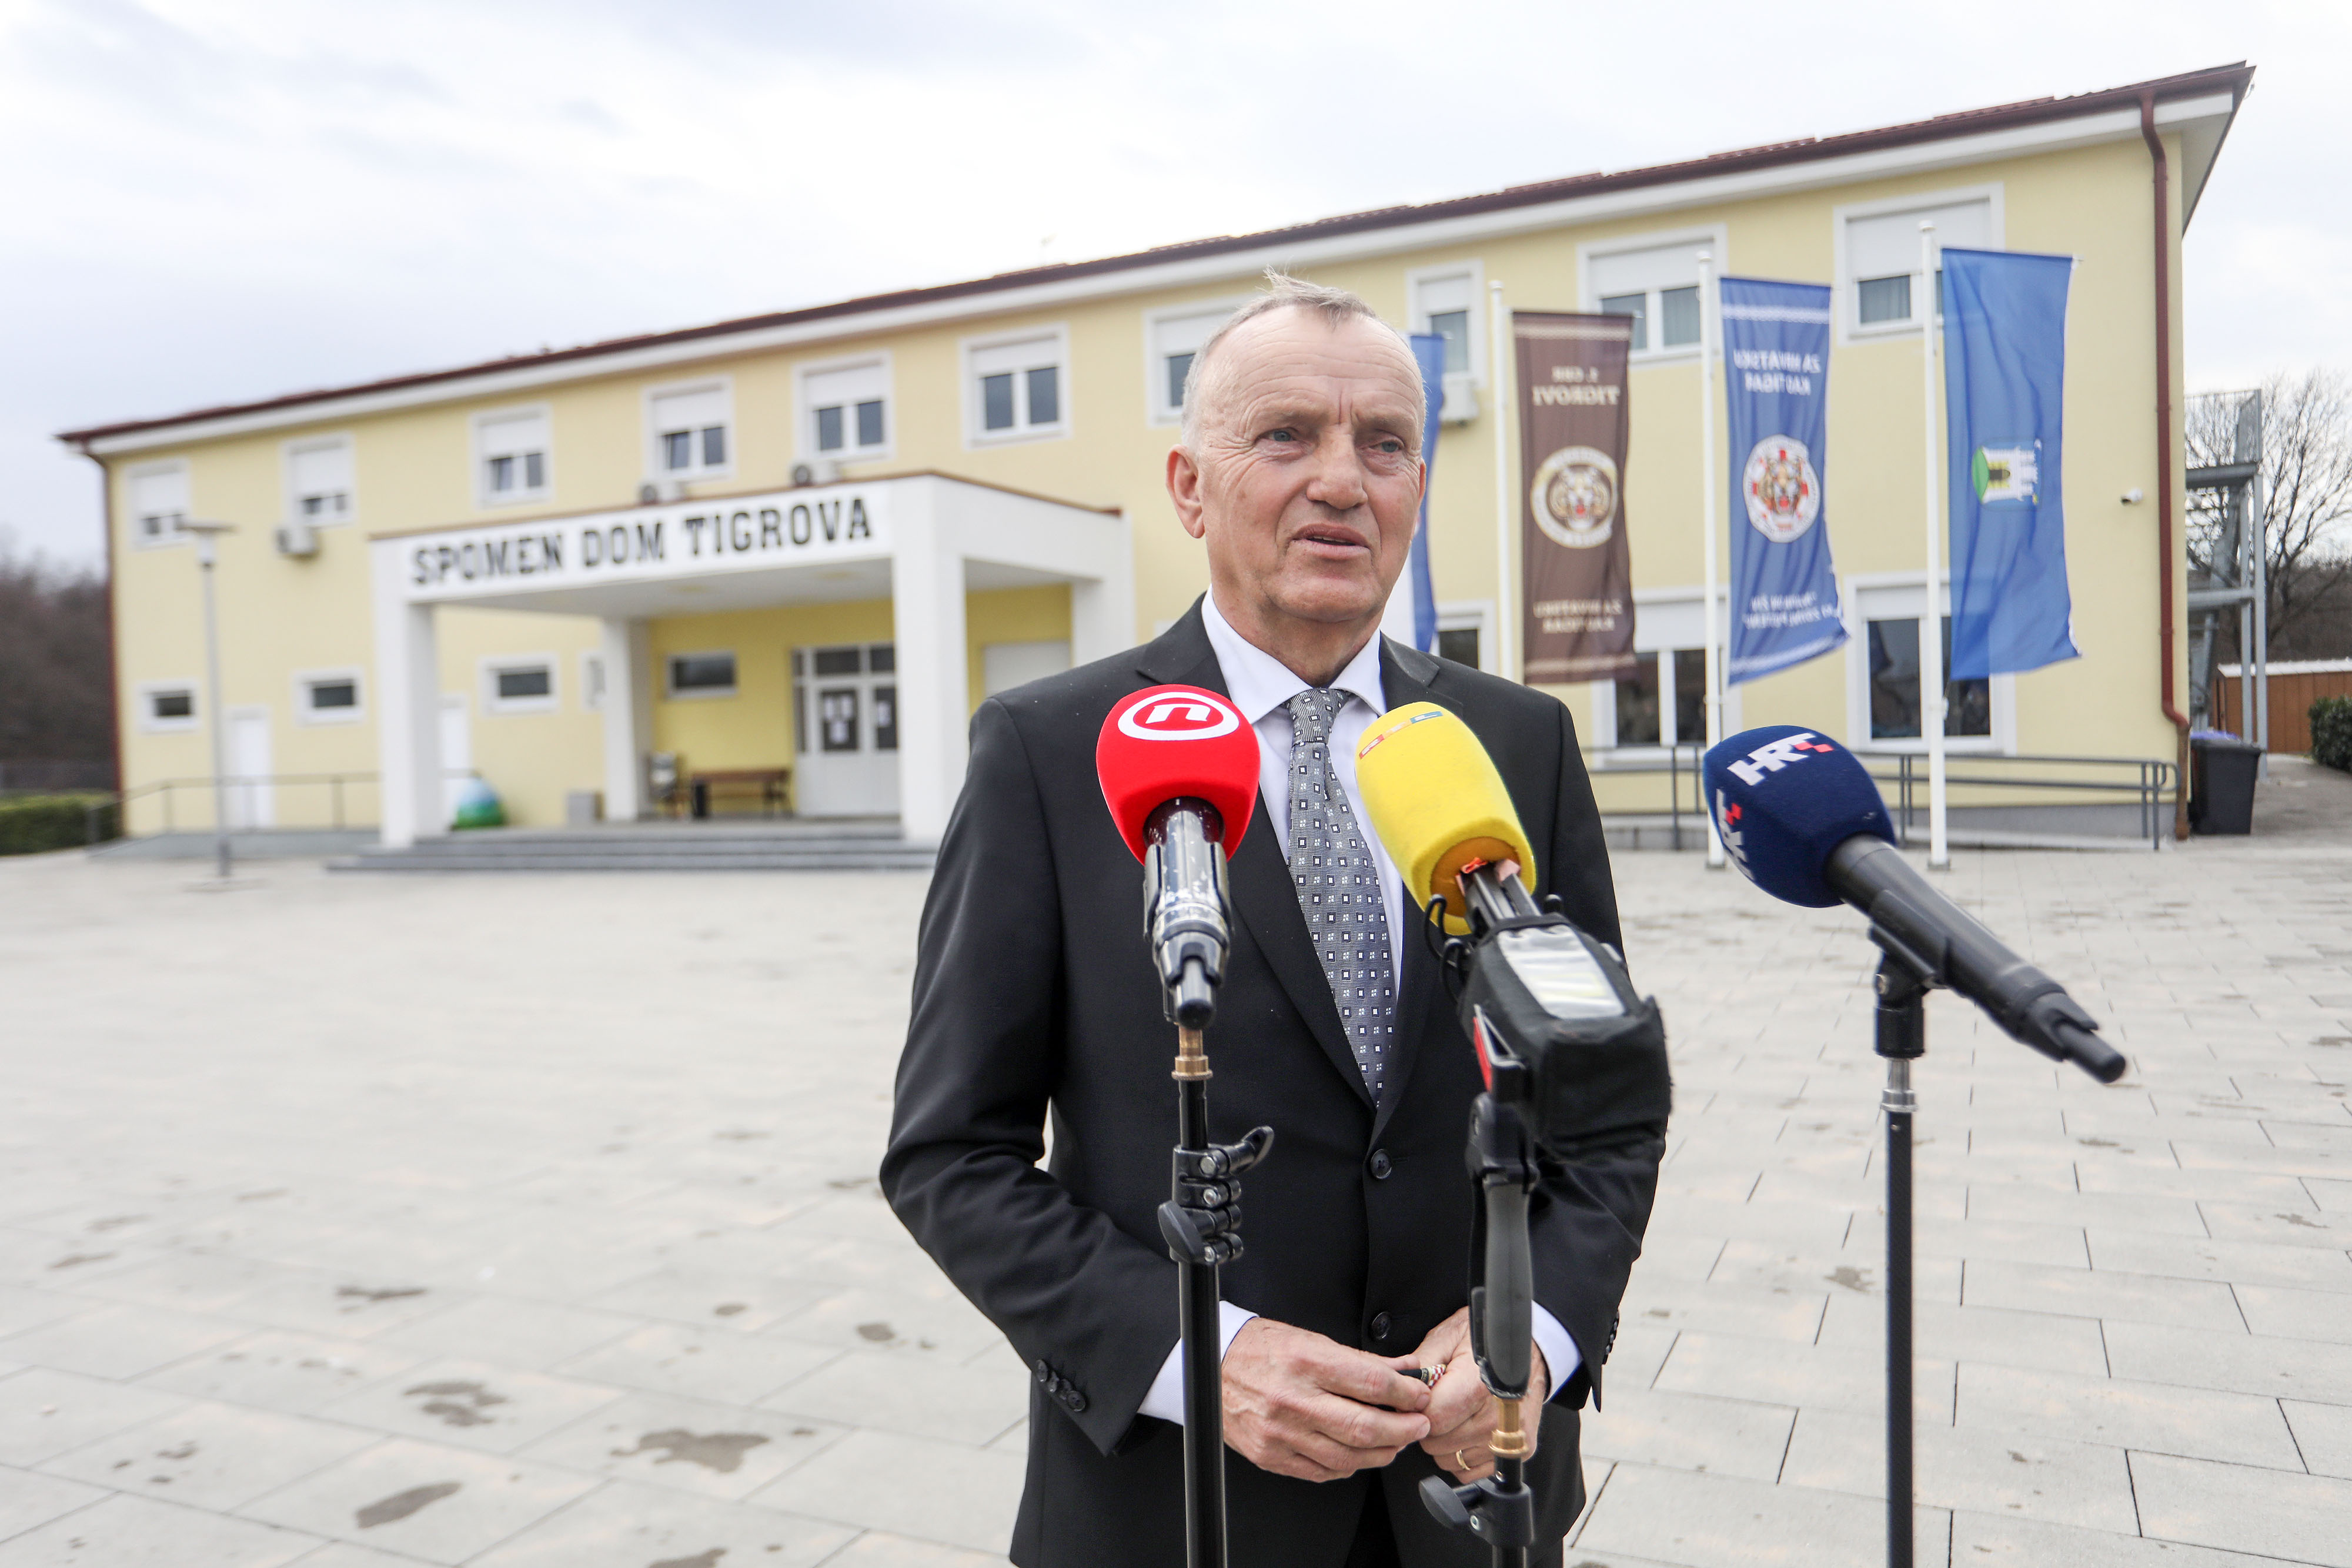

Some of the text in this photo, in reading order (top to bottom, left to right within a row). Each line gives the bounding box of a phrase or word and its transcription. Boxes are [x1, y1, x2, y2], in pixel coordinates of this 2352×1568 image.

[415, 497, 871, 584] SPOMEN DOM TIGROVA
[1727, 733, 1817, 786] HRT
